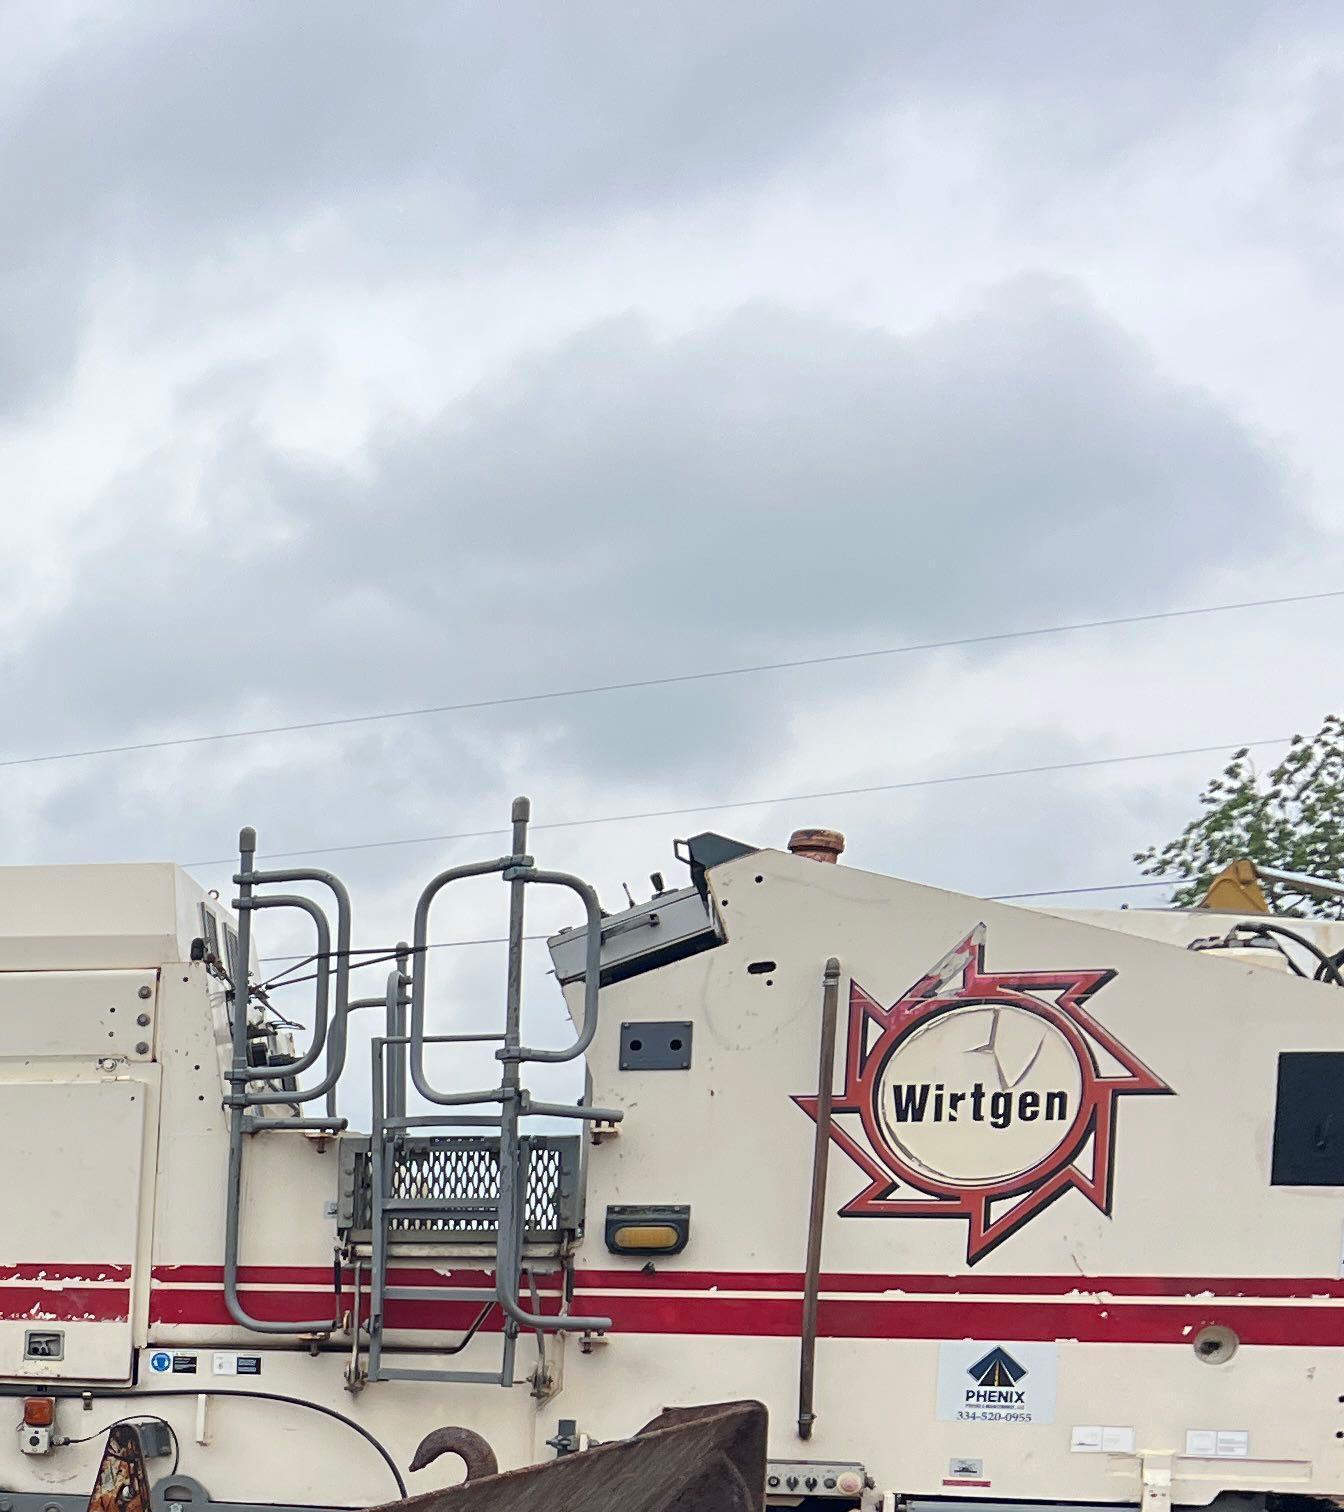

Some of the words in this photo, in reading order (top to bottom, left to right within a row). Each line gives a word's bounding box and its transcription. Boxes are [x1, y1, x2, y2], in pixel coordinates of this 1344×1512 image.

[892, 1082, 1069, 1130] Wirtgen
[965, 1389, 1025, 1404] PHENIX
[956, 1410, 1033, 1423] 334-520-0955
